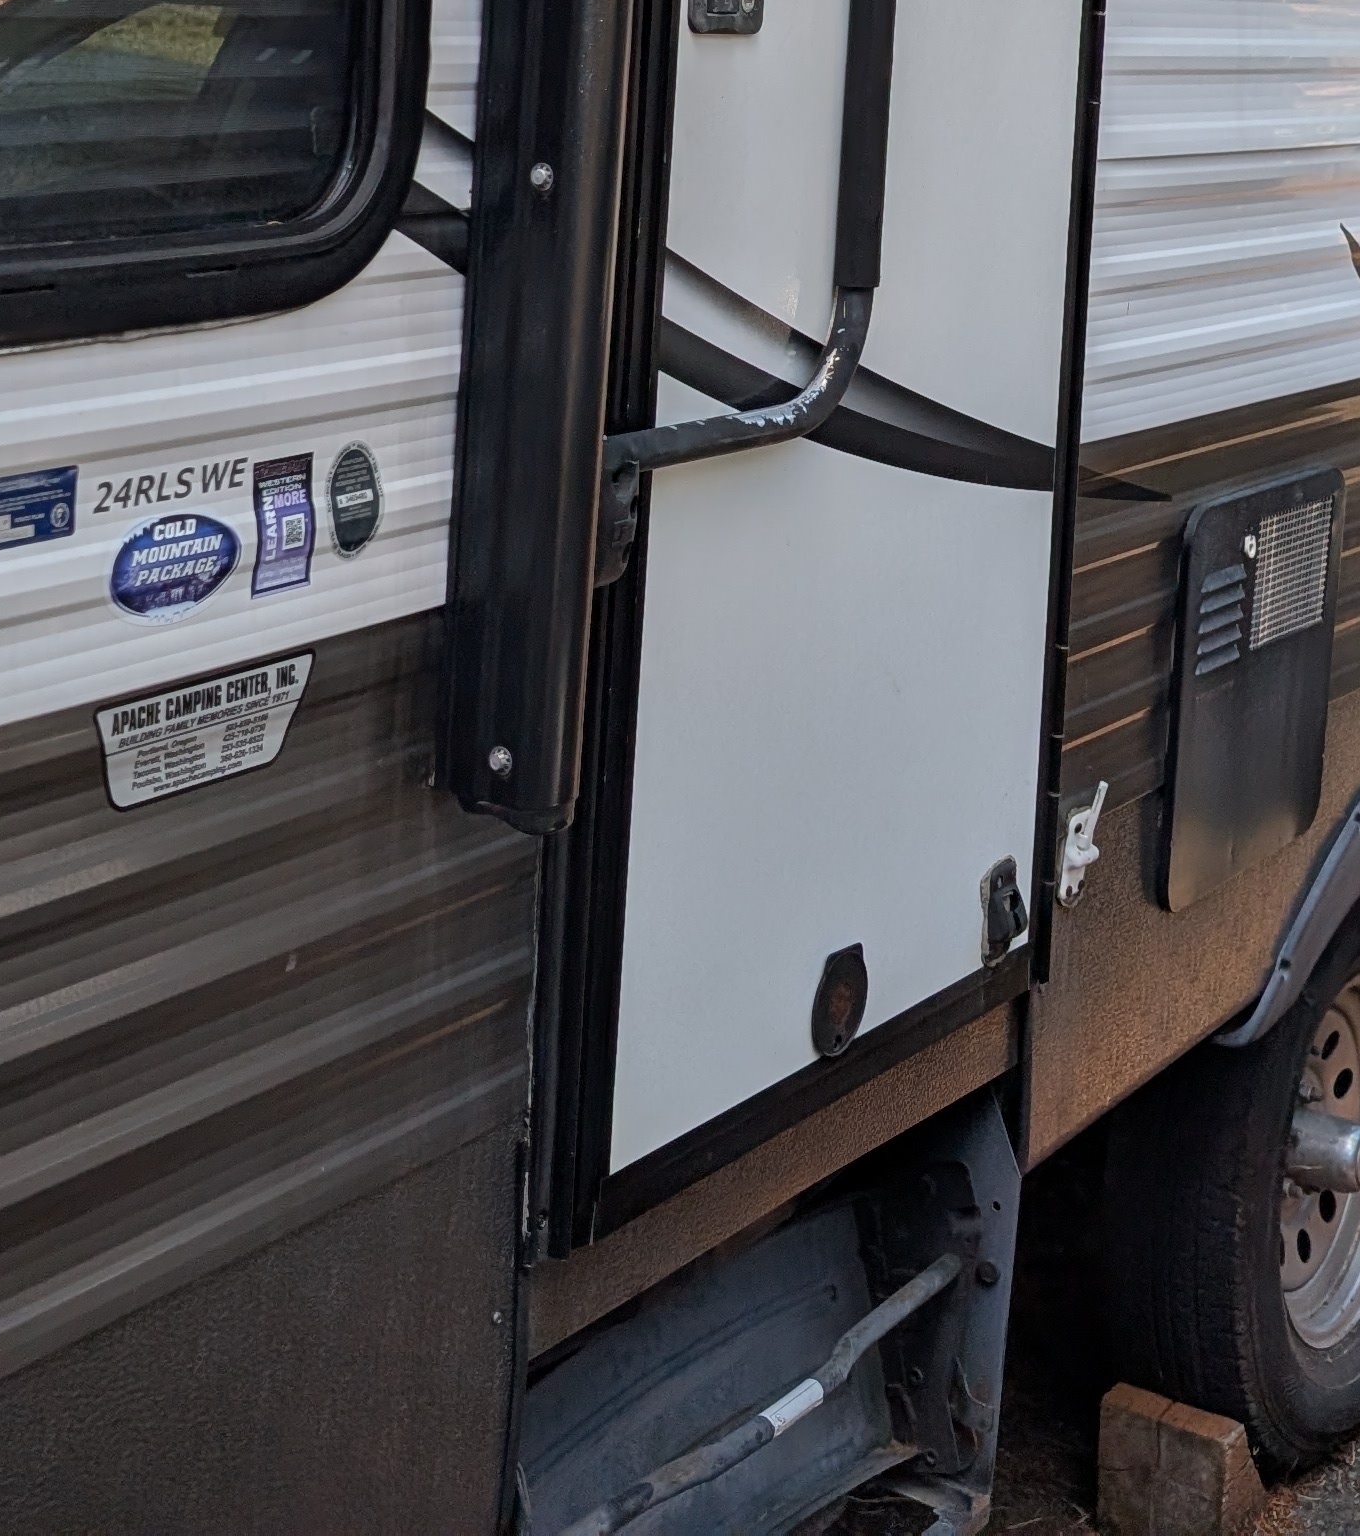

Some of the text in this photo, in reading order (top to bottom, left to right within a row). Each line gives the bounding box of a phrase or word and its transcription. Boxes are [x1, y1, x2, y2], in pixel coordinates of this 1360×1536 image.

[258, 472, 307, 489] WESTERN
[262, 483, 302, 497] EDITION
[273, 488, 307, 509] MORE
[152, 518, 198, 542] COLD
[262, 495, 278, 562] LEARN
[131, 533, 224, 567] MOUNTAIN
[133, 555, 218, 587] PACKAGE
[111, 663, 299, 737] APACHE CAMPING CENTER, INC.
[118, 690, 290, 749] BUILDING FAMILY MEMORIES SINCE 1971
[163, 743, 206, 761] Washington
[170, 735, 198, 749] Oregon
[164, 752, 206, 770] Washington
[165, 762, 207, 781] Washington
